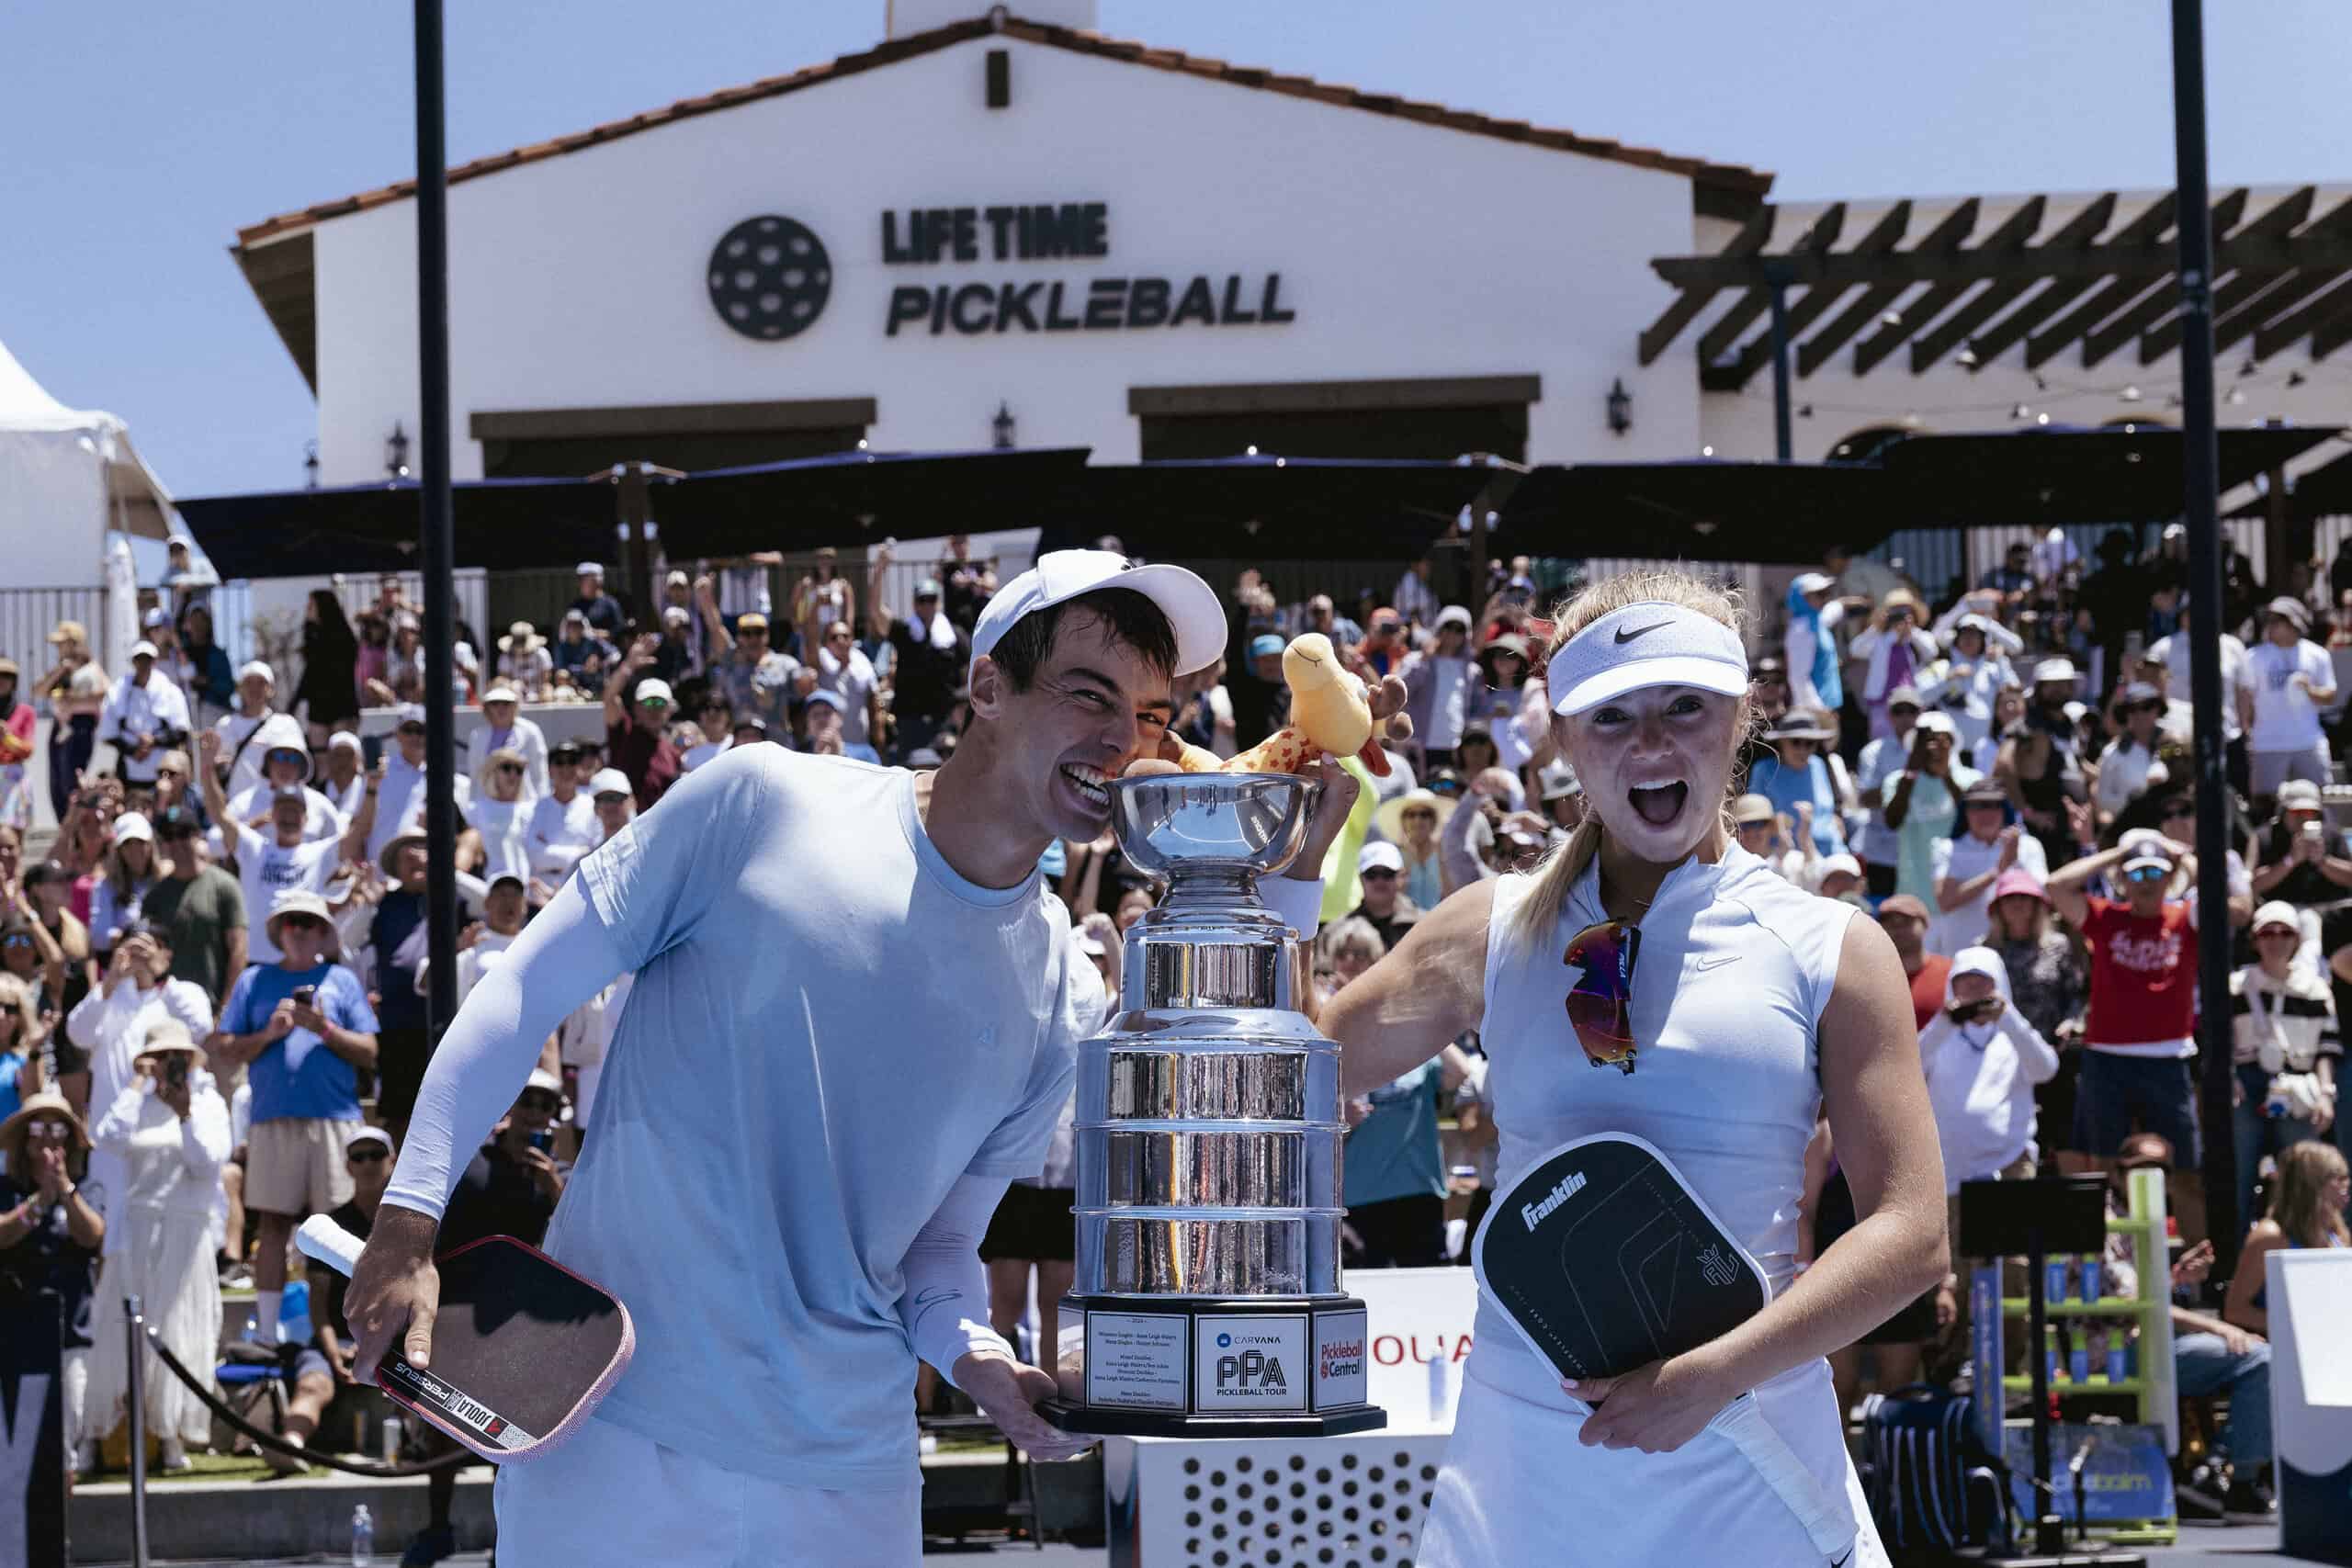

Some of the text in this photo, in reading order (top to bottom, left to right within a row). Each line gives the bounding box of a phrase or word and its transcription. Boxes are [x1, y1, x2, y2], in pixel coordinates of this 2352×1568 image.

[881, 202, 1109, 264] LIFE TIME
[885, 273, 1295, 337] PICKLEBALL
[1521, 1170, 1588, 1233] Franklin
[1234, 1337, 1281, 1345] CARVANA
[1321, 1338, 1363, 1359] Pickleball
[1216, 1349, 1287, 1387] PPA
[1329, 1359, 1360, 1378] Central
[395, 1362, 492, 1427] JOOLA PERSEUS
[1216, 1388, 1287, 1396] PICKLEBALL TOUR
